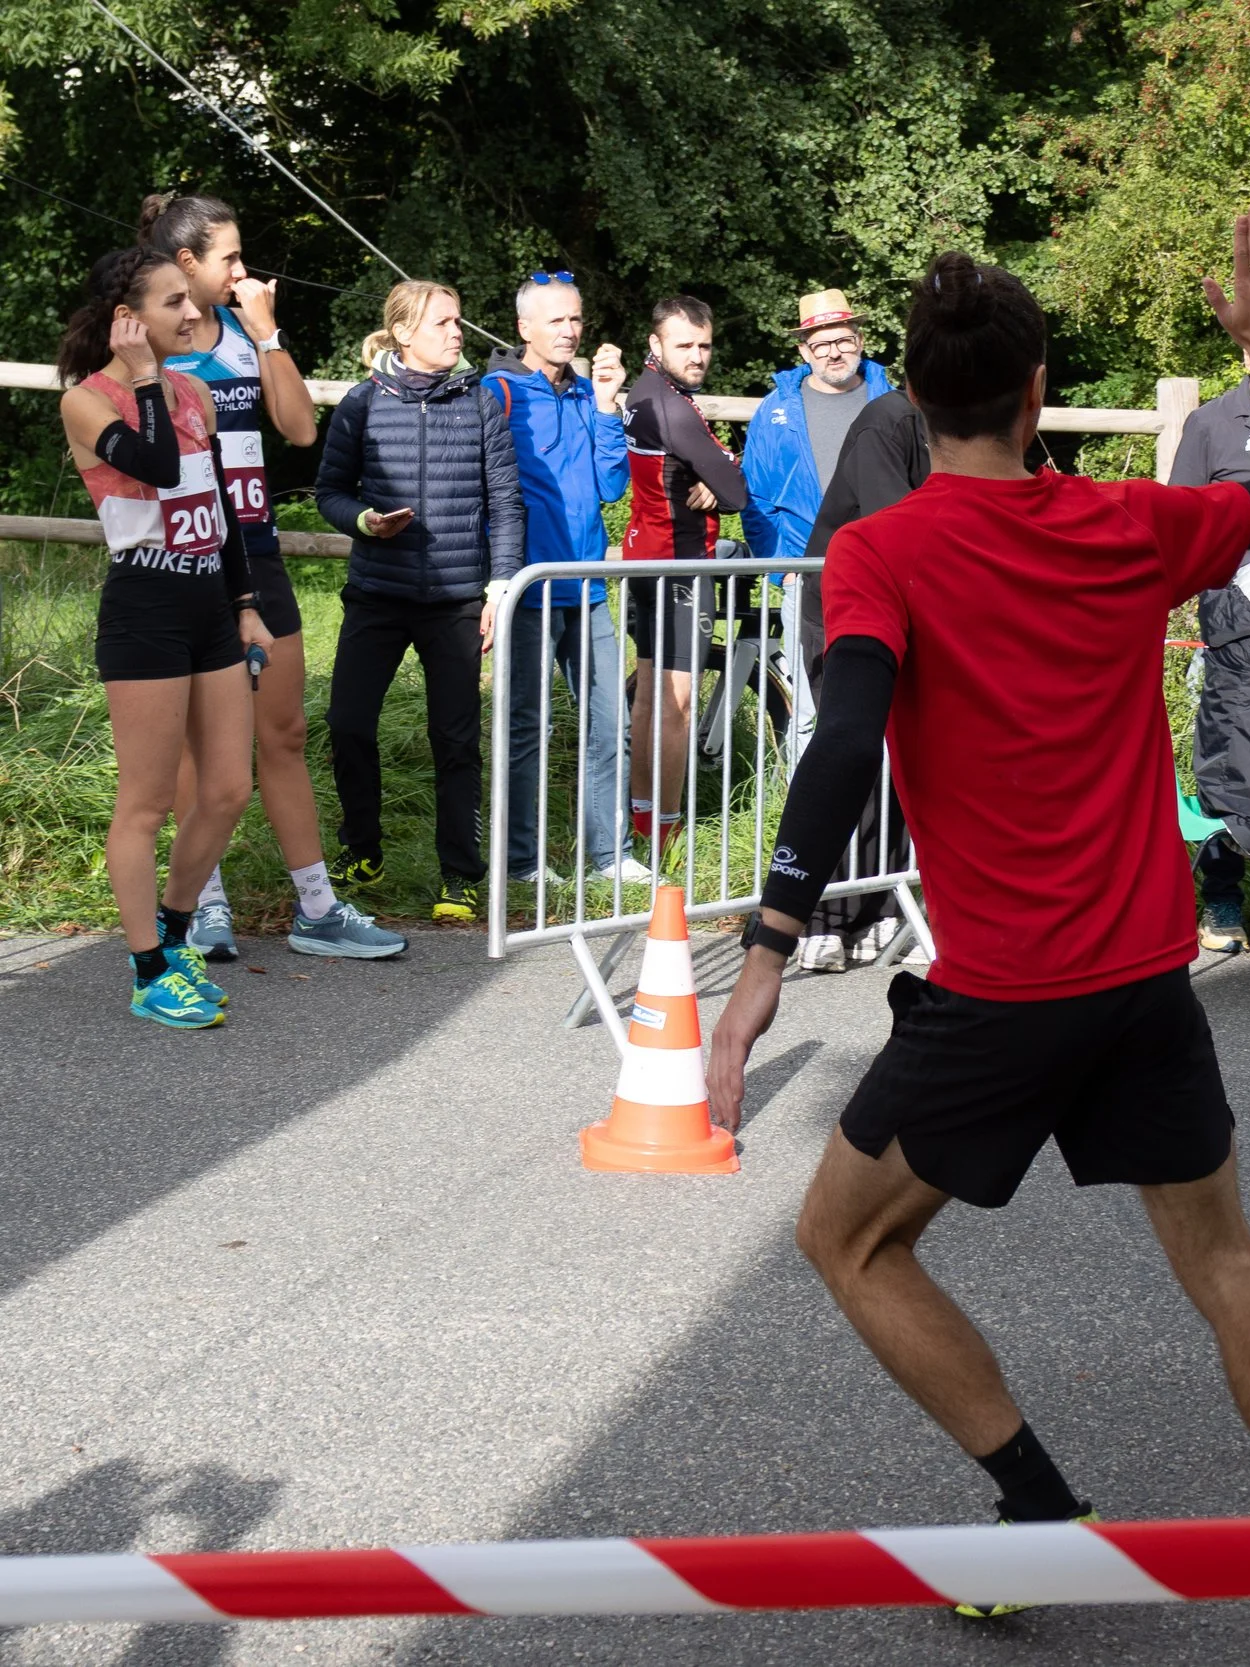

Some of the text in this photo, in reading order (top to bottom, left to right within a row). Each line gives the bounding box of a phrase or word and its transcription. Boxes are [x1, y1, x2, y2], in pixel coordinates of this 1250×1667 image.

[171, 502, 220, 545] 201
[131, 547, 194, 574] NIKE
[770, 863, 810, 880] SPORT
